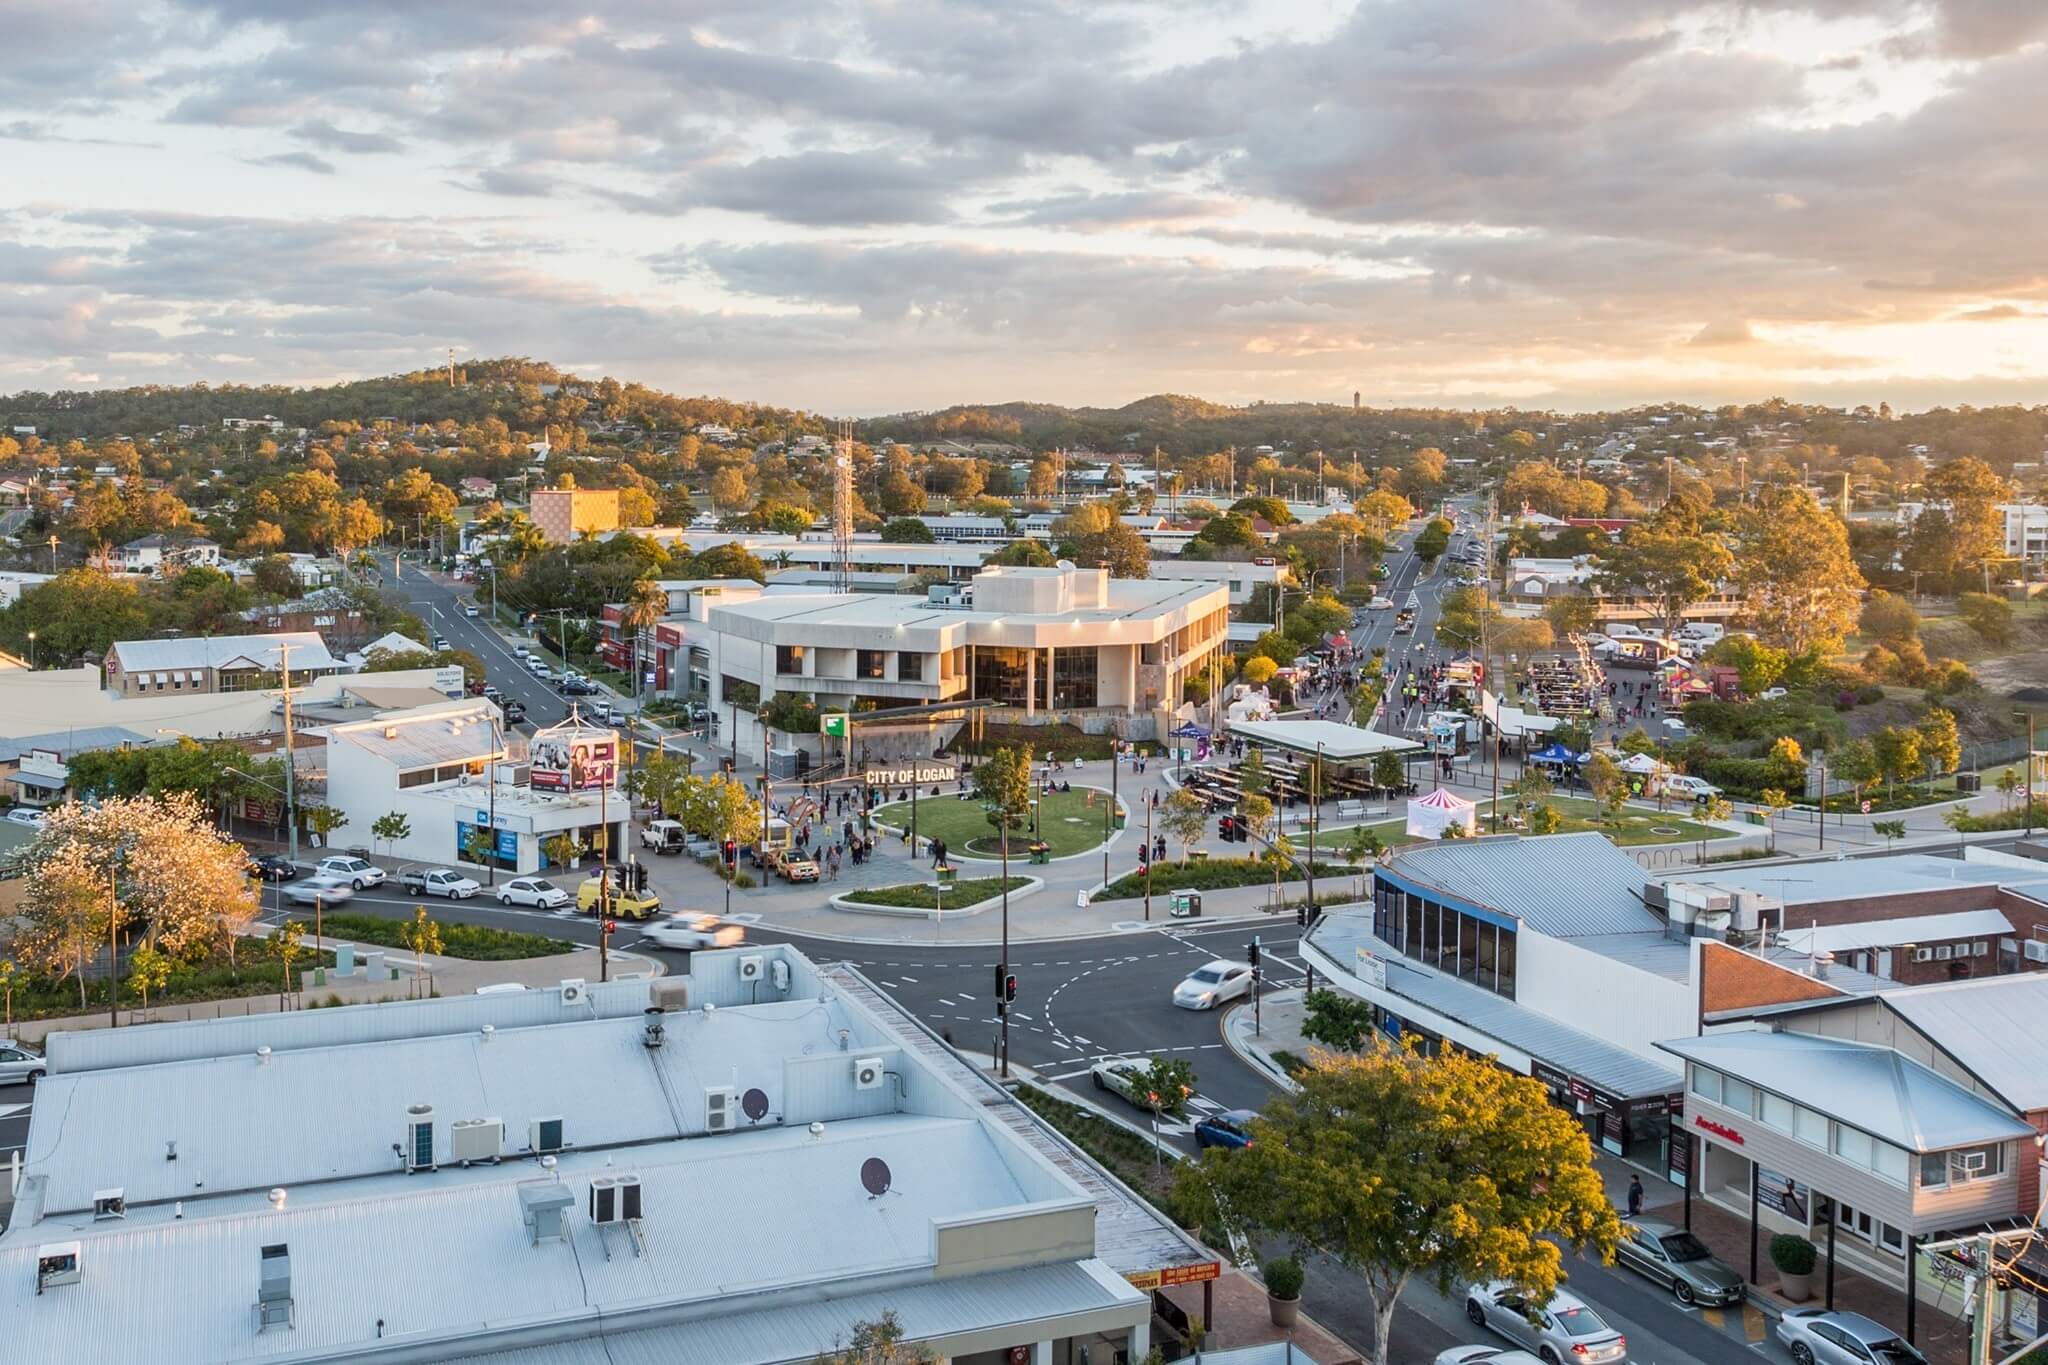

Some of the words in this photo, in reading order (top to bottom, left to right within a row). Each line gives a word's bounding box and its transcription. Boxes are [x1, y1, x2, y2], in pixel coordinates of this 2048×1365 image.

[866, 770, 896, 784] CITY
[899, 769, 914, 783] OF
[916, 767, 955, 782] LOGAN
